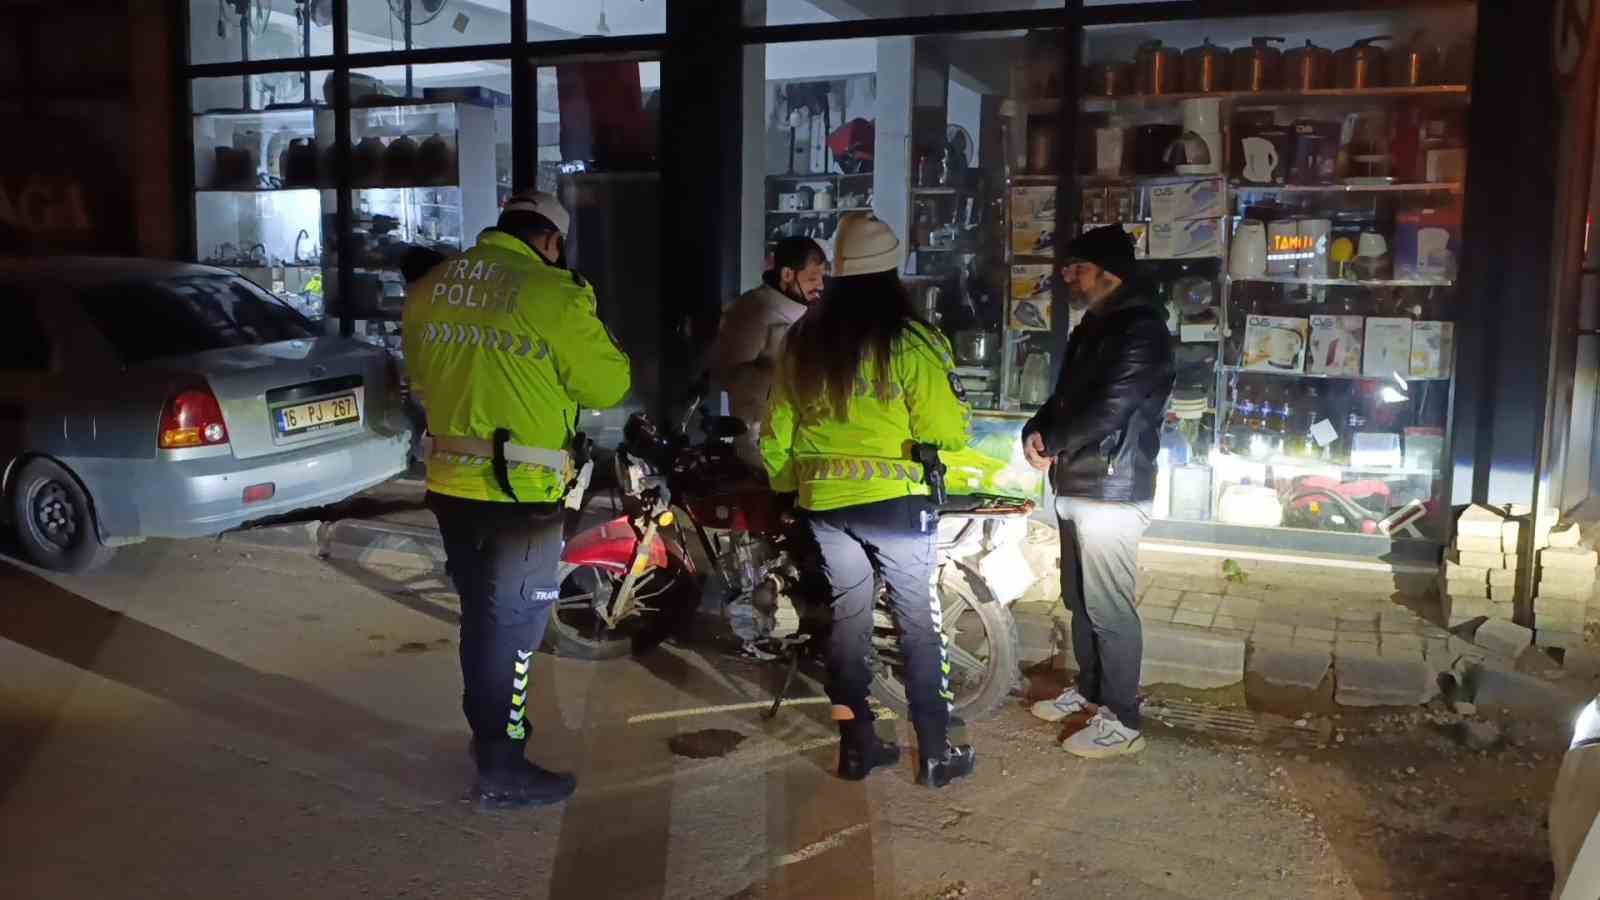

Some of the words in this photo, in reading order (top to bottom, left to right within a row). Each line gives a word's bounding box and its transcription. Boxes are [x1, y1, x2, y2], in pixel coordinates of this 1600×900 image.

[283, 409, 297, 428] 16
[307, 405, 324, 423] PJ
[332, 398, 352, 418] 267
